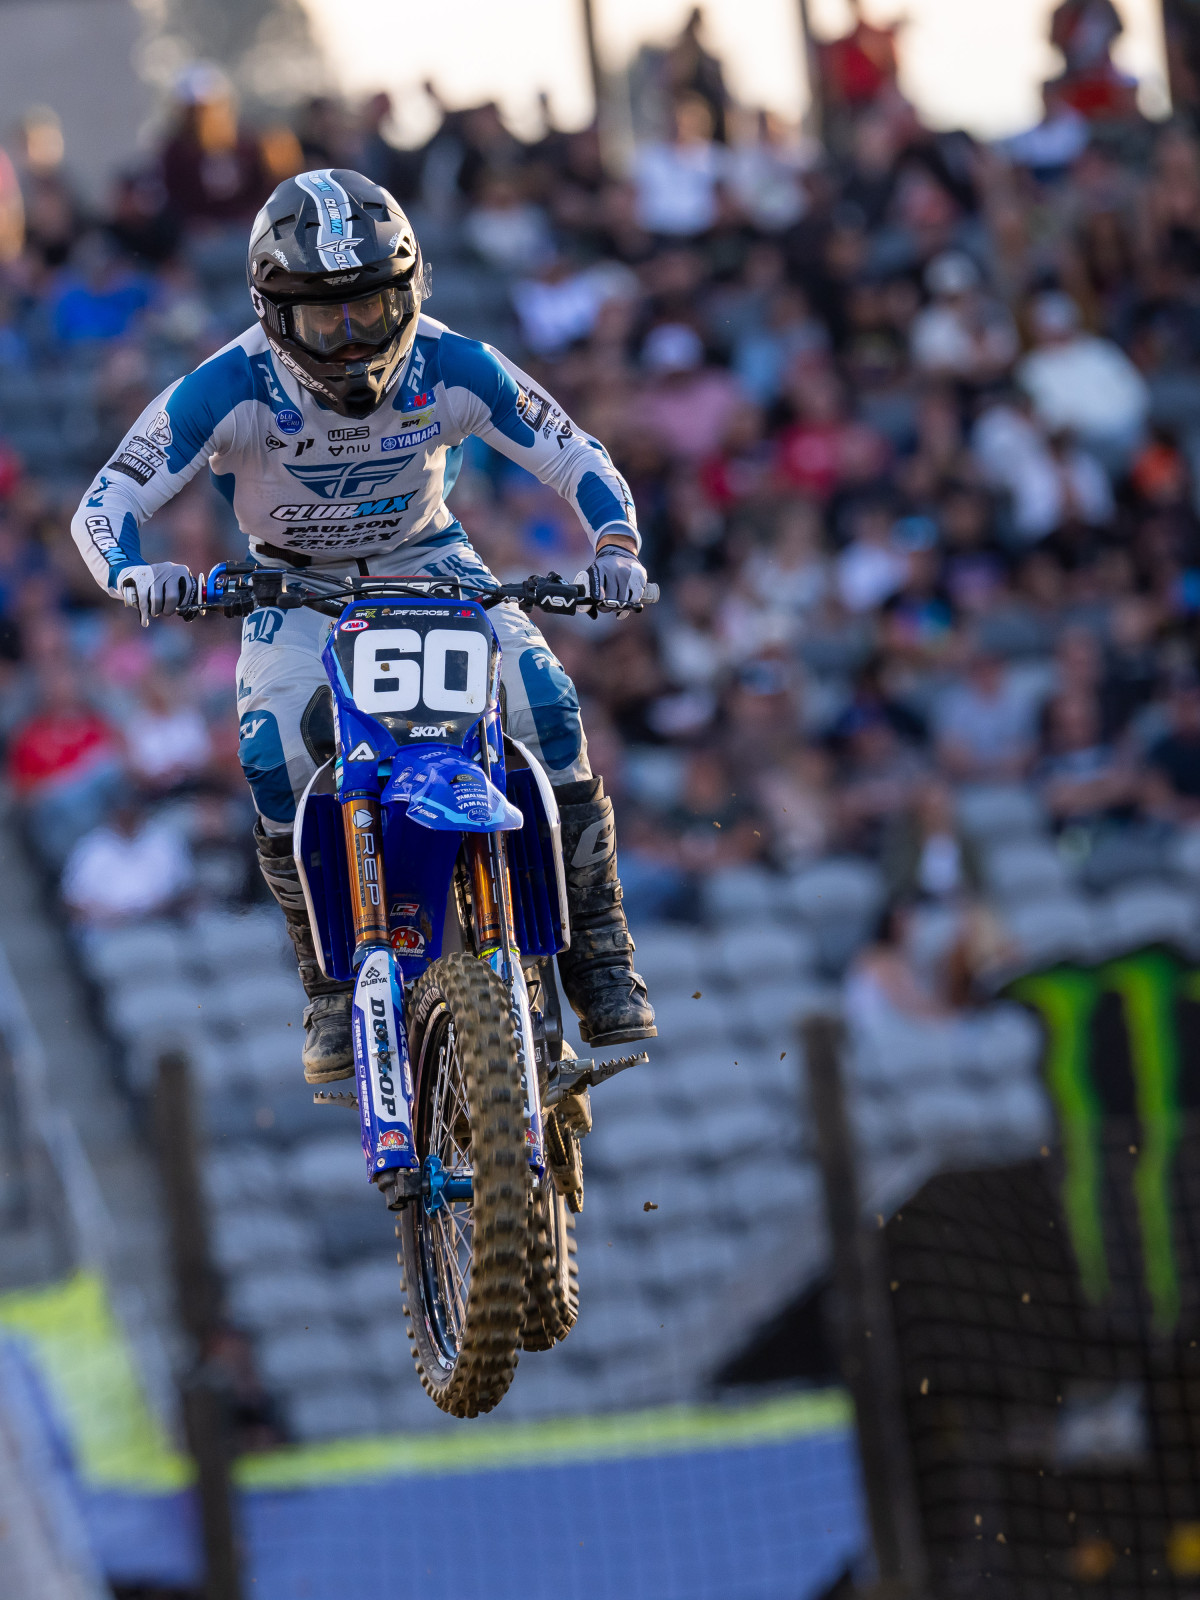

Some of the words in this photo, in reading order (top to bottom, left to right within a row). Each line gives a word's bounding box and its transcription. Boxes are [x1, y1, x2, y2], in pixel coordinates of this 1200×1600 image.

[323, 198, 344, 236] CLUBMX
[407, 345, 426, 393] FLY
[257, 363, 284, 403] FLY
[400, 408, 434, 429] SMX
[328, 426, 370, 442] WPS
[397, 423, 440, 448] YAMAHA
[121, 454, 153, 479] YAMAHA
[270, 489, 420, 521] CLUBMX
[282, 517, 402, 535] PAULSON
[283, 530, 401, 547] STUSSY
[500, 595, 525, 603] ASV
[540, 595, 576, 608] ASV
[602, 599, 628, 609] ASV
[355, 608, 377, 618] SMX
[381, 609, 450, 617] SUPERCROSS
[345, 620, 366, 630] AMA
[353, 629, 489, 714] 60
[409, 726, 447, 738] SKDA
[458, 800, 493, 810] YAMAHA
[362, 832, 380, 906] REP
[360, 976, 388, 988] DUBYA
[359, 1079, 371, 1128] WISECO
